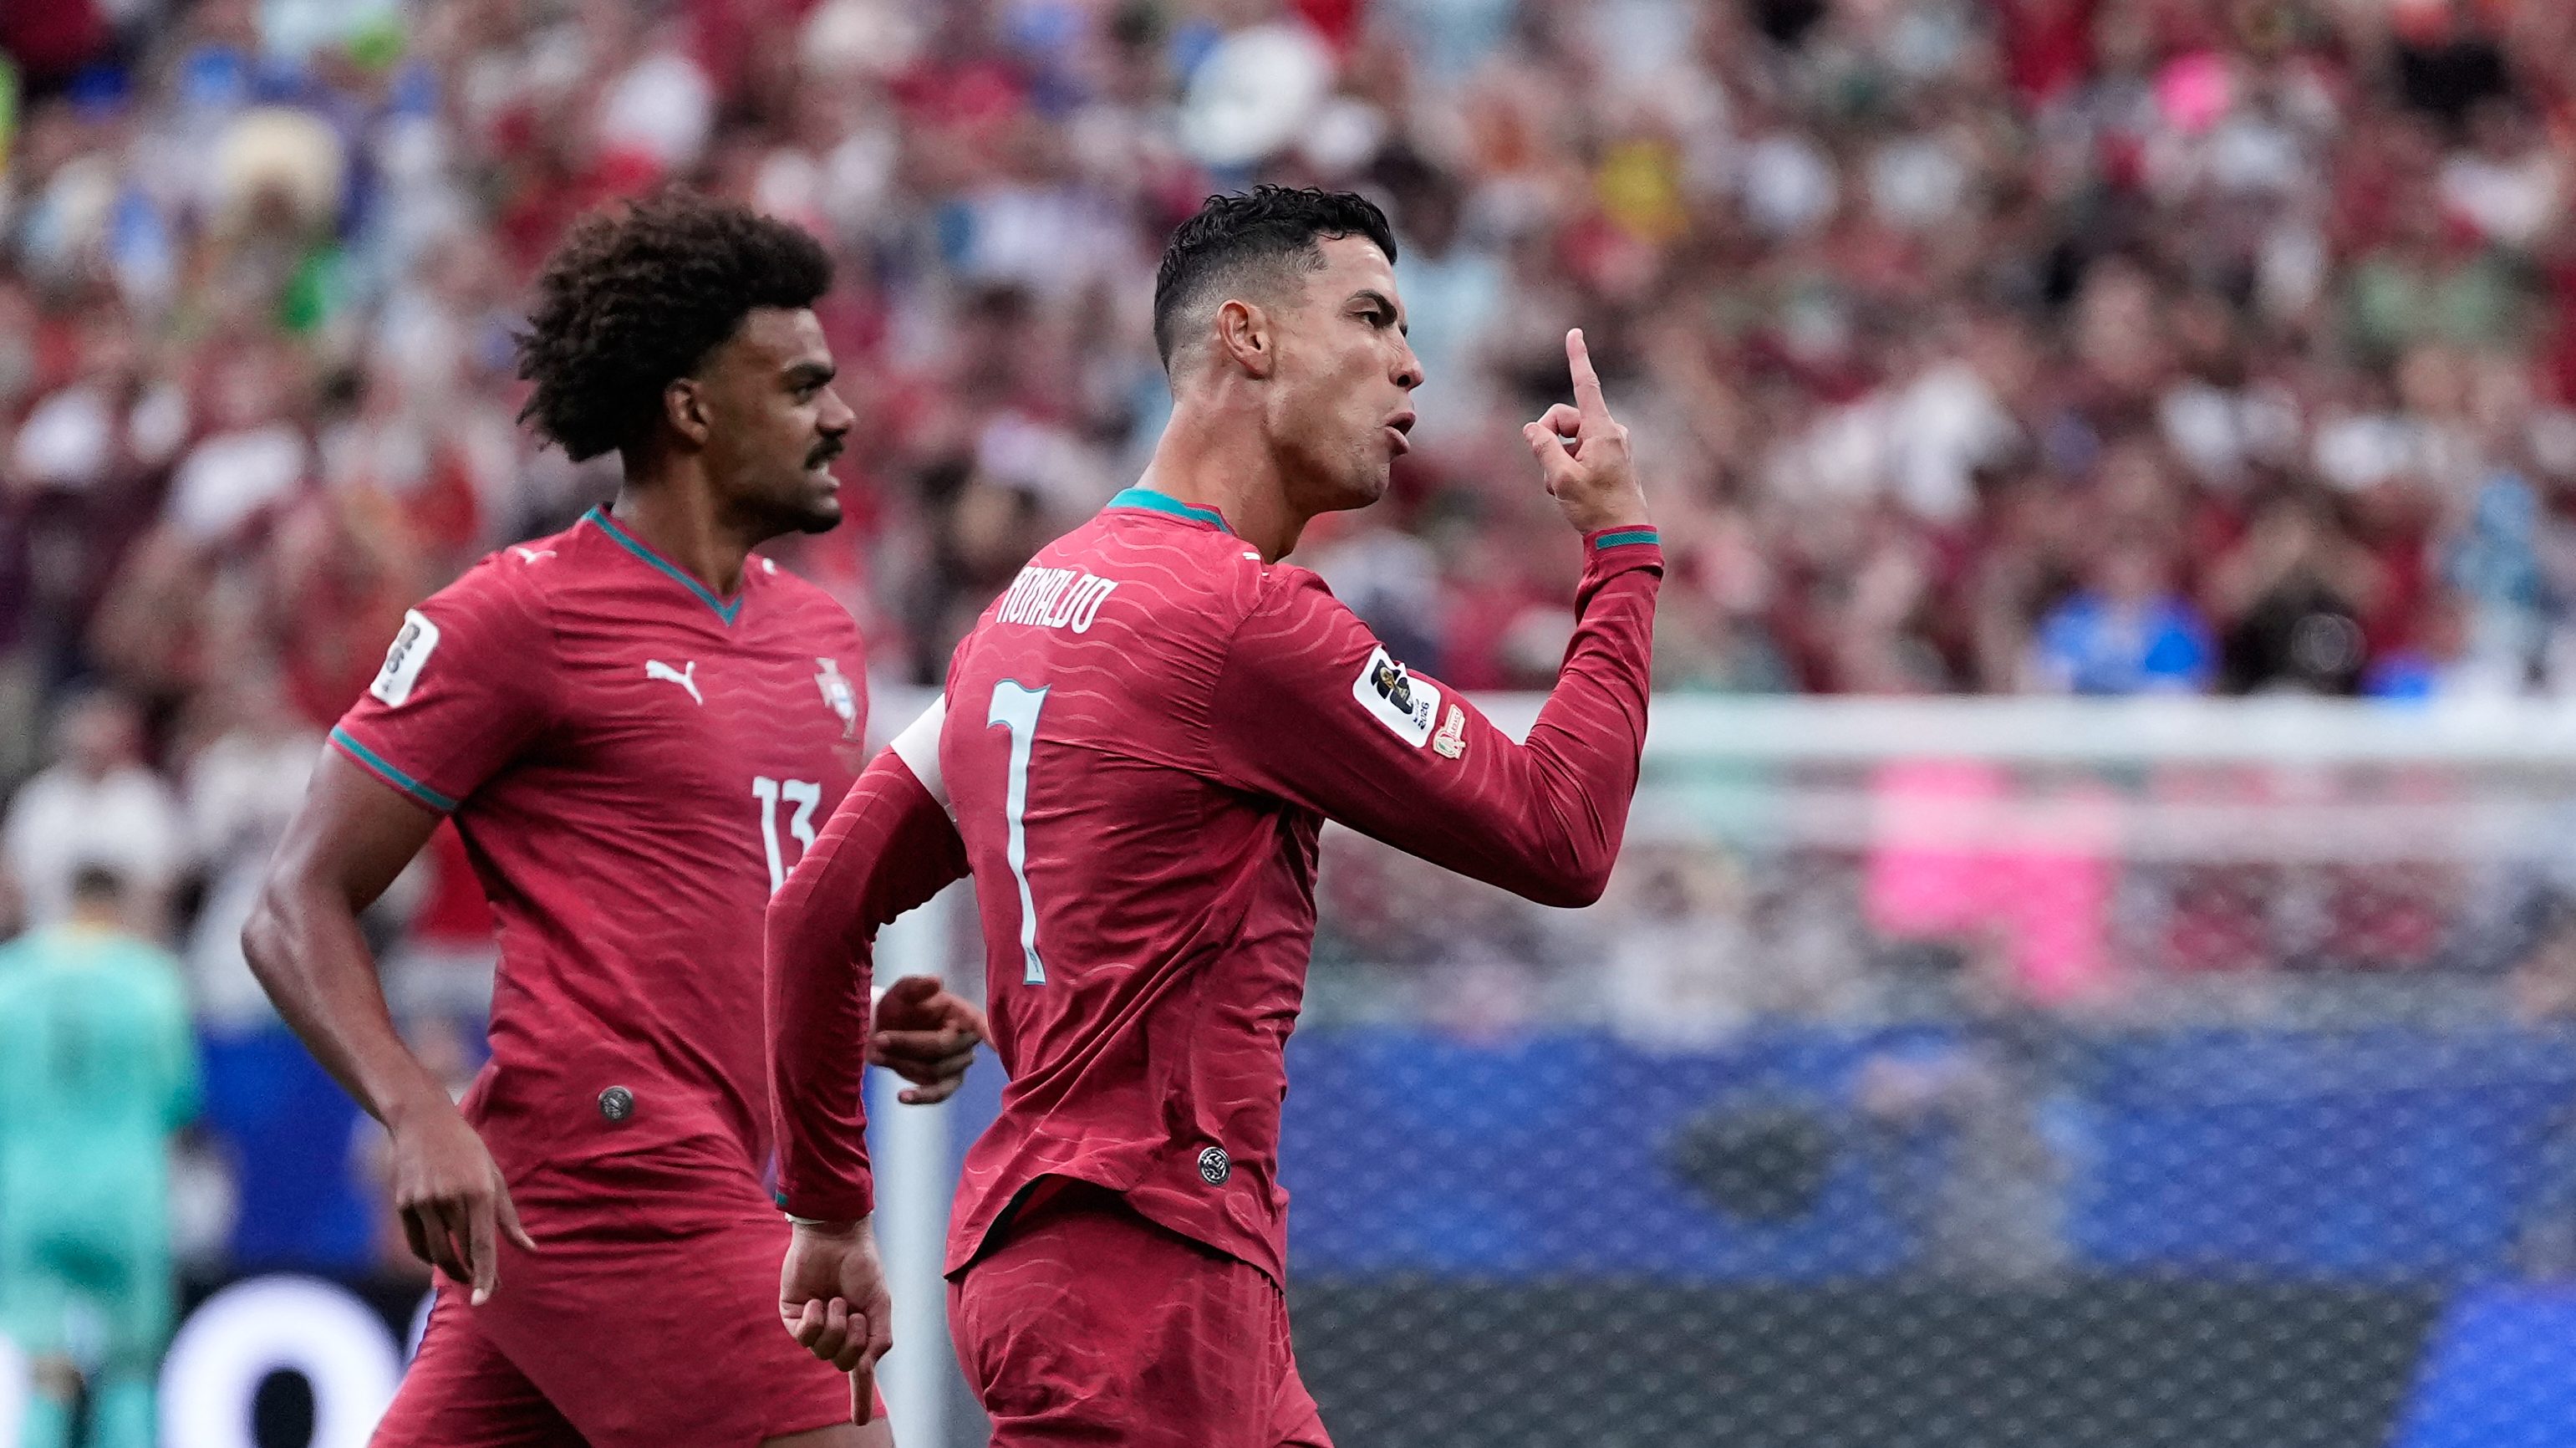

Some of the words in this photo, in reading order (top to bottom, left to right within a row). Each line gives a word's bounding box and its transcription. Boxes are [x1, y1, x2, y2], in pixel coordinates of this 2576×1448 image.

[995, 565, 1119, 634] RONALDO
[1418, 701, 1430, 730] 2026
[752, 776, 822, 895] 13
[986, 677, 1051, 986] 7
